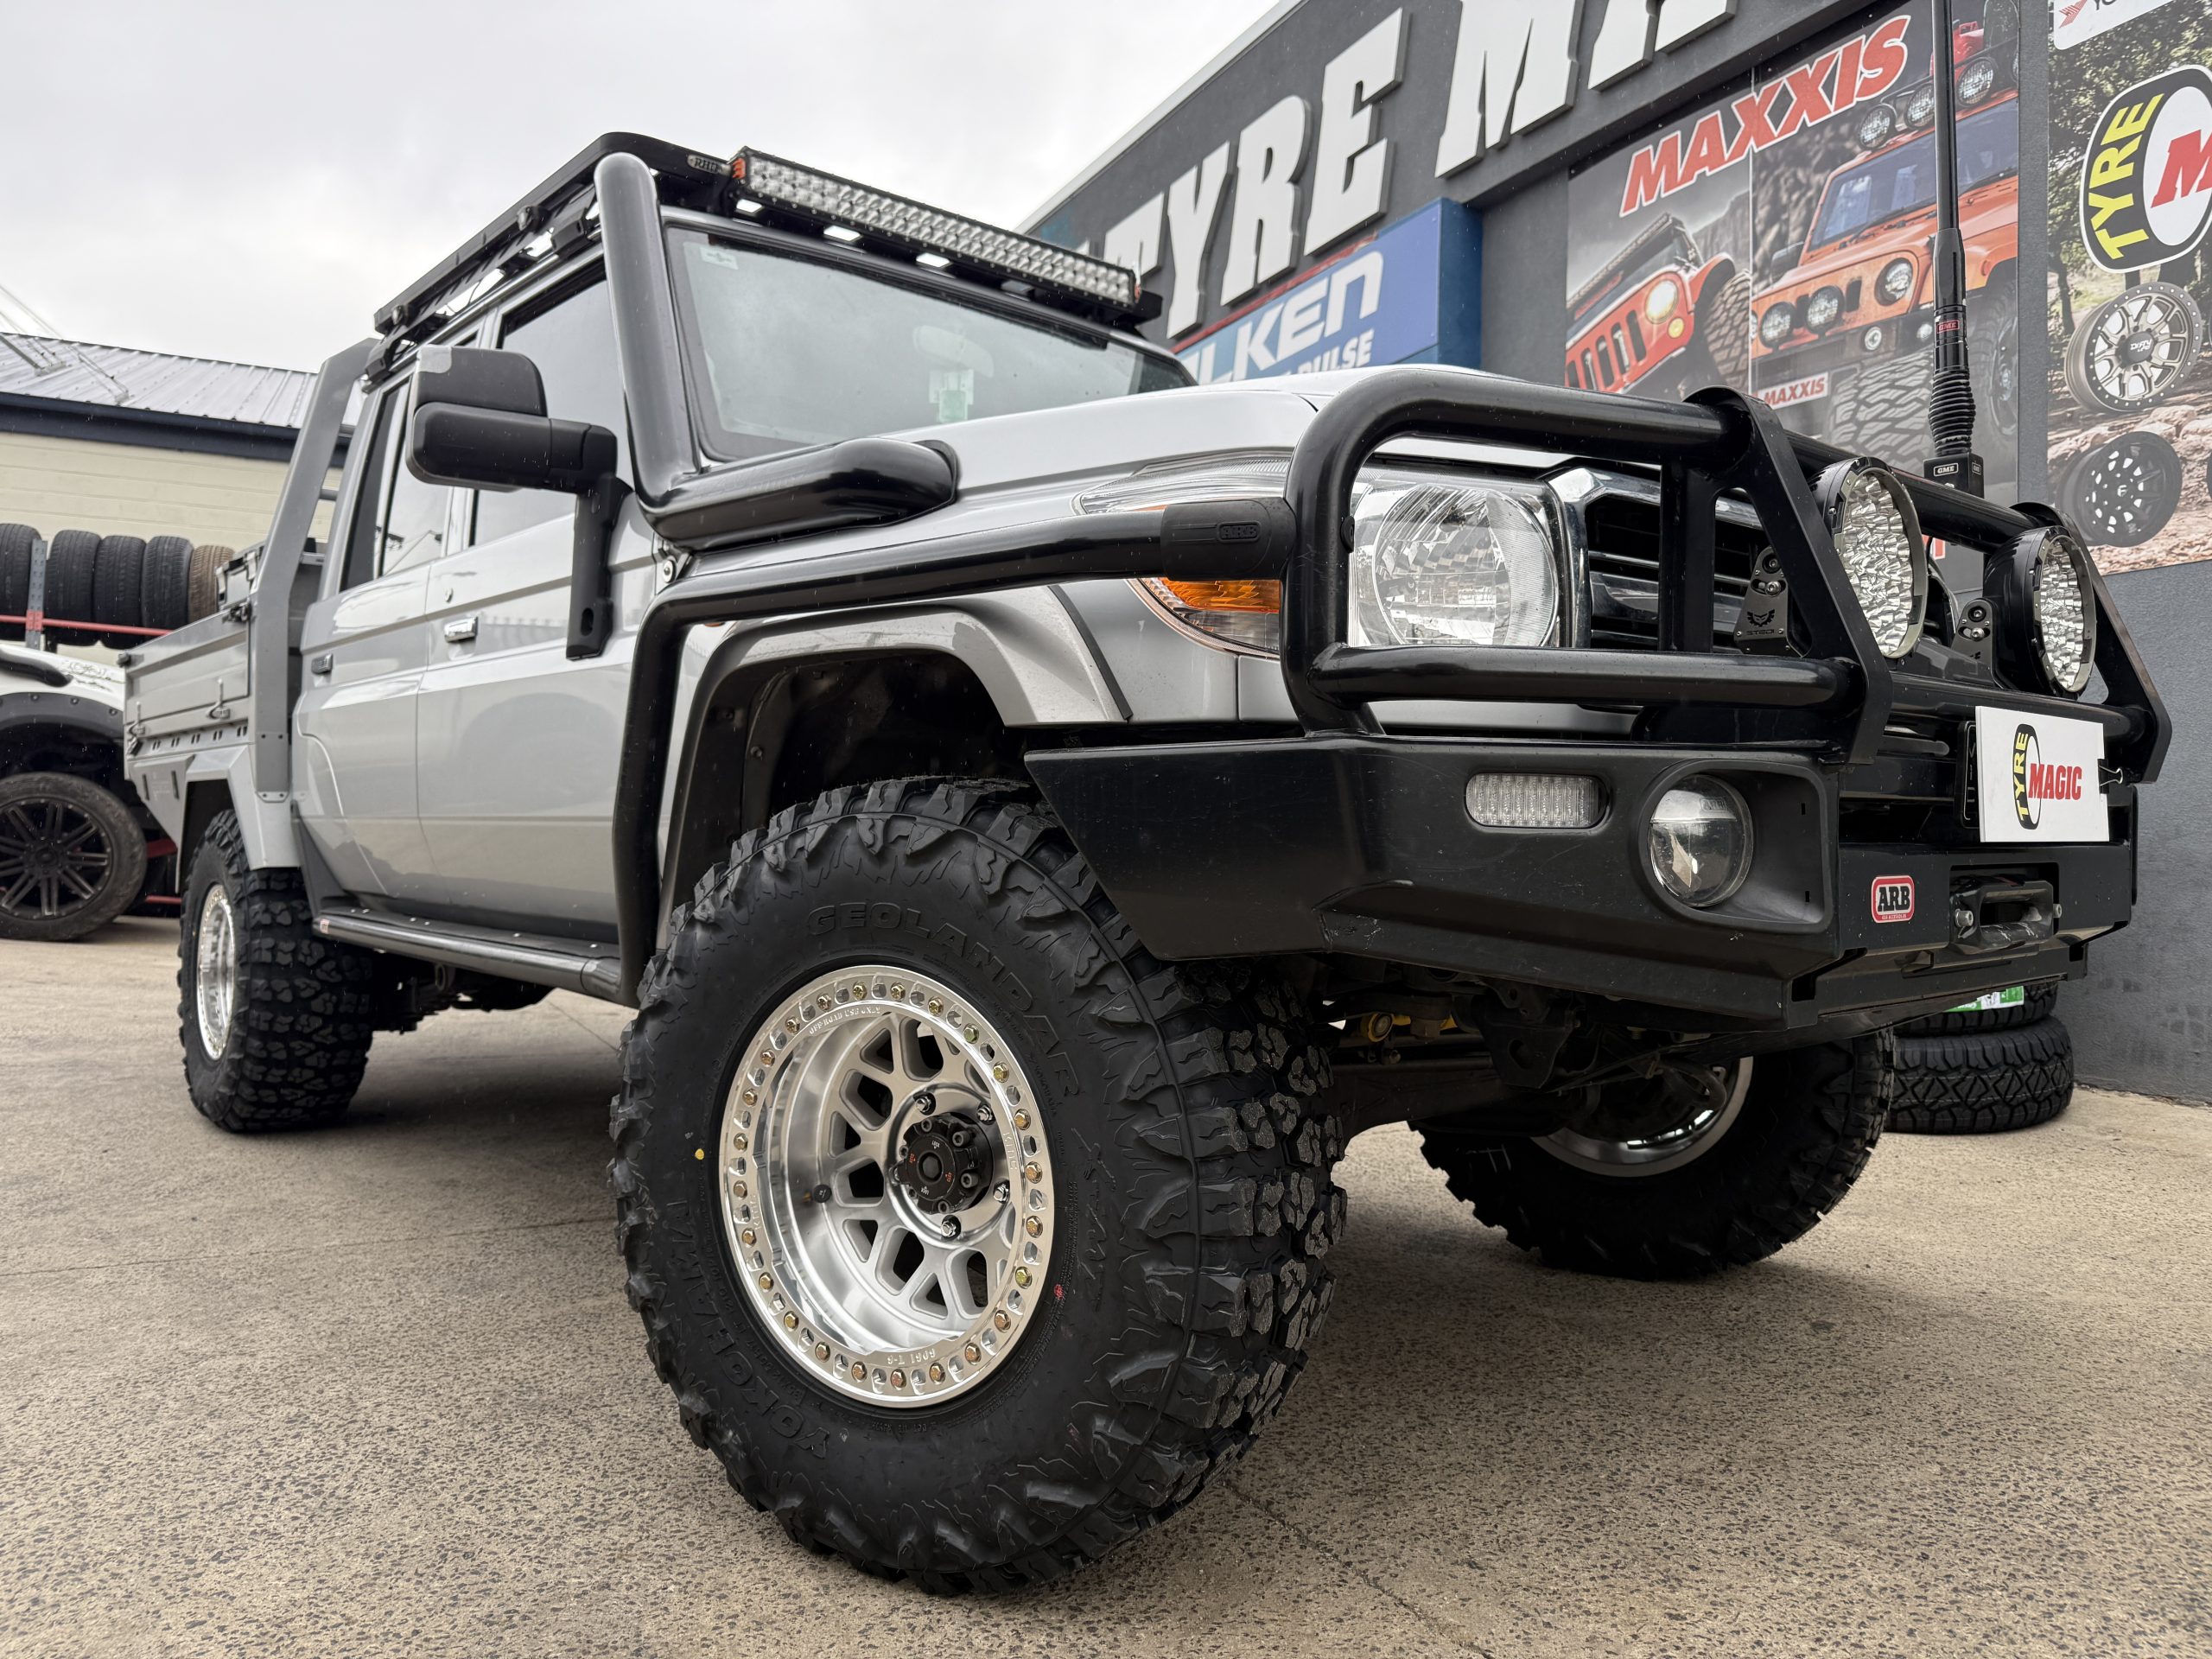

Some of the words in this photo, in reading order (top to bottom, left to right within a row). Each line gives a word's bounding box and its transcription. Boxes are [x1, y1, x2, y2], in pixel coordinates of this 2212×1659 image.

[1620, 15, 1910, 217] MAXXIS
[2088, 93, 2164, 259] TYRE
[1764, 377, 1825, 406] MAXXIS
[1937, 465, 1955, 474] GME
[2013, 732, 2029, 821] TYRE
[2028, 763, 2082, 800] MAGIC
[1878, 886, 1910, 912] ARB
[807, 902, 1080, 1097] GEOLANDAR
[666, 1199, 830, 1459] YOKOHAMA
